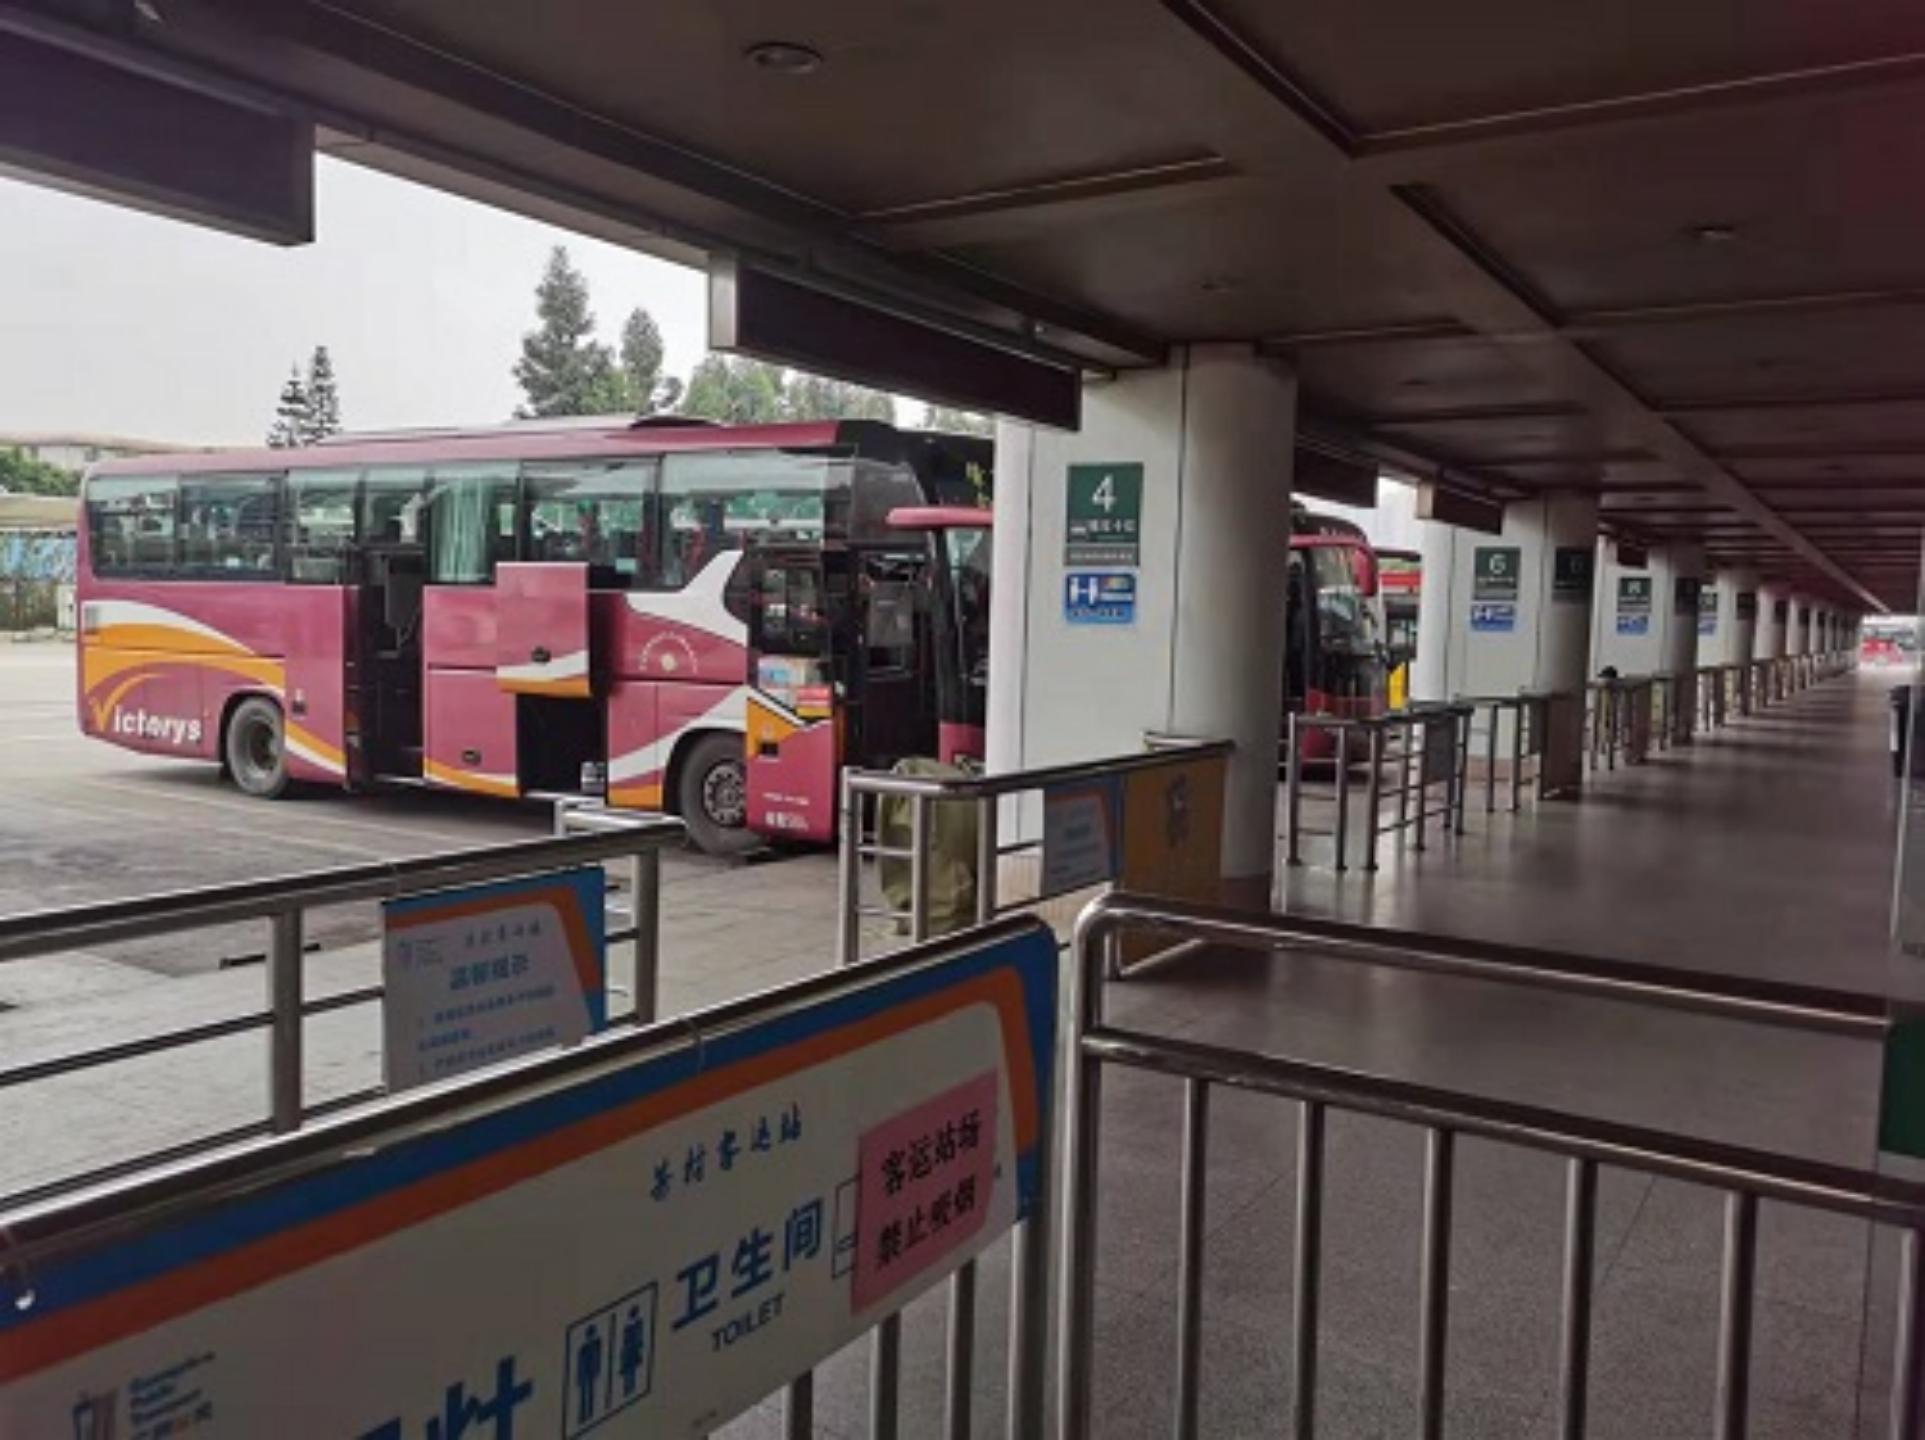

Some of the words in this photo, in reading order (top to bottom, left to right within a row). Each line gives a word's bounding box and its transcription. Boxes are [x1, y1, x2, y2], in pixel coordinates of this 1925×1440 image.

[1091, 473, 1117, 512] 4
[881, 1108, 981, 1195] 客运站场
[671, 1197, 823, 1331] 卫生间
[711, 1292, 786, 1351] TOILET
